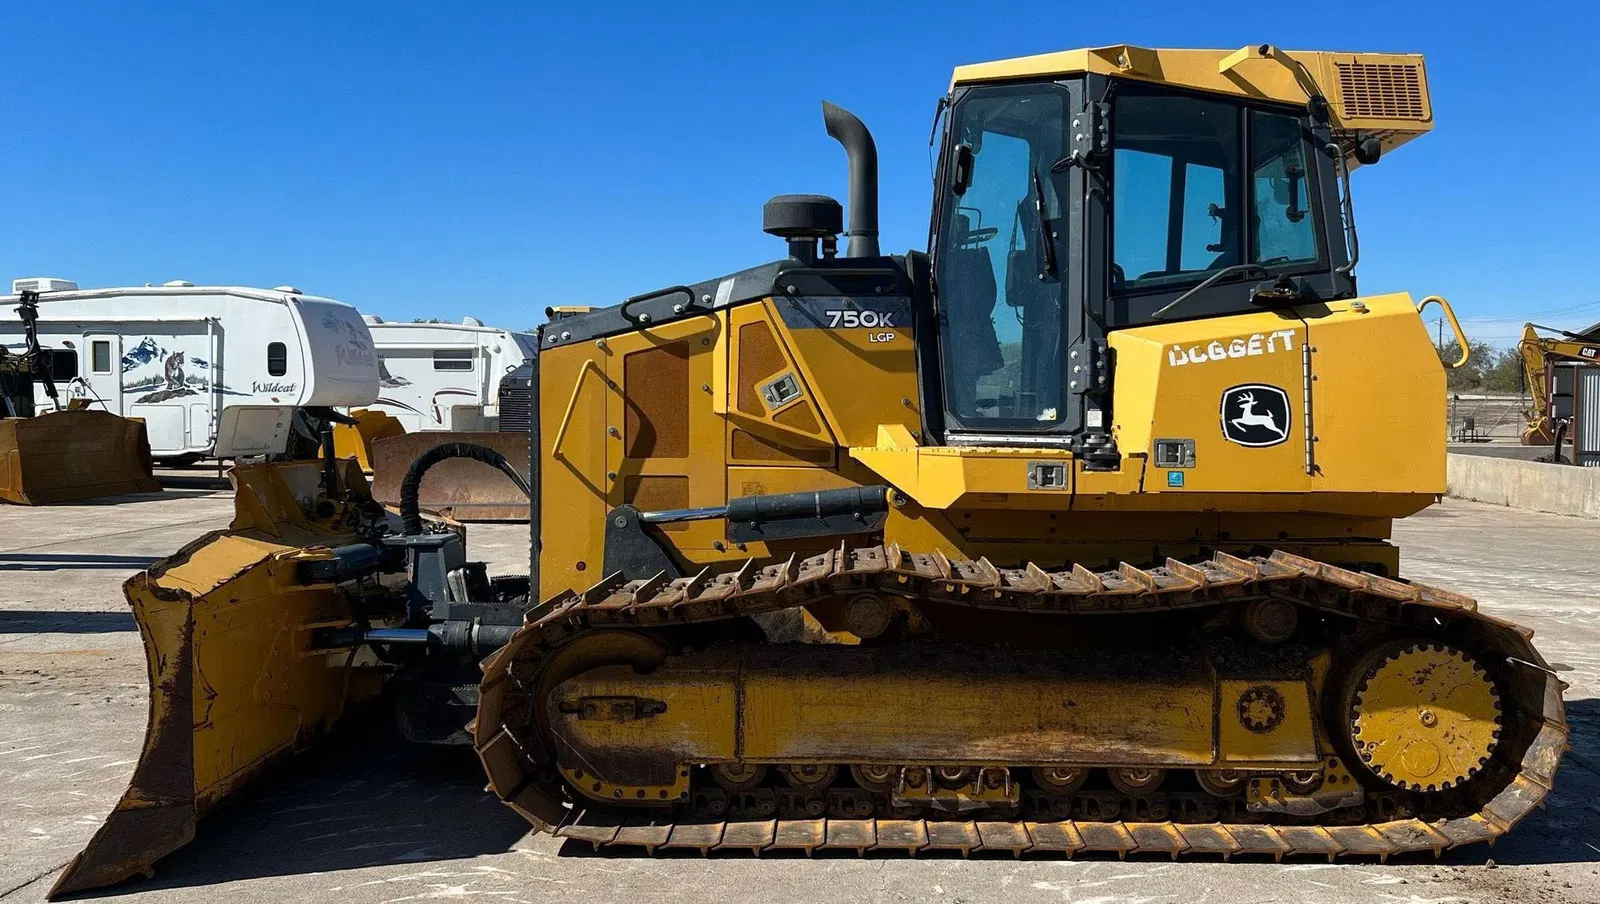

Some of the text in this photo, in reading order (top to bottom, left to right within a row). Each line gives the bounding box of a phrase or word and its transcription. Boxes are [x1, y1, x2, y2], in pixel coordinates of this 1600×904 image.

[826, 310, 895, 328] 750K
[869, 332, 895, 343] LGP
[1582, 347, 1597, 358] CAT
[252, 380, 296, 393] Wildcat
